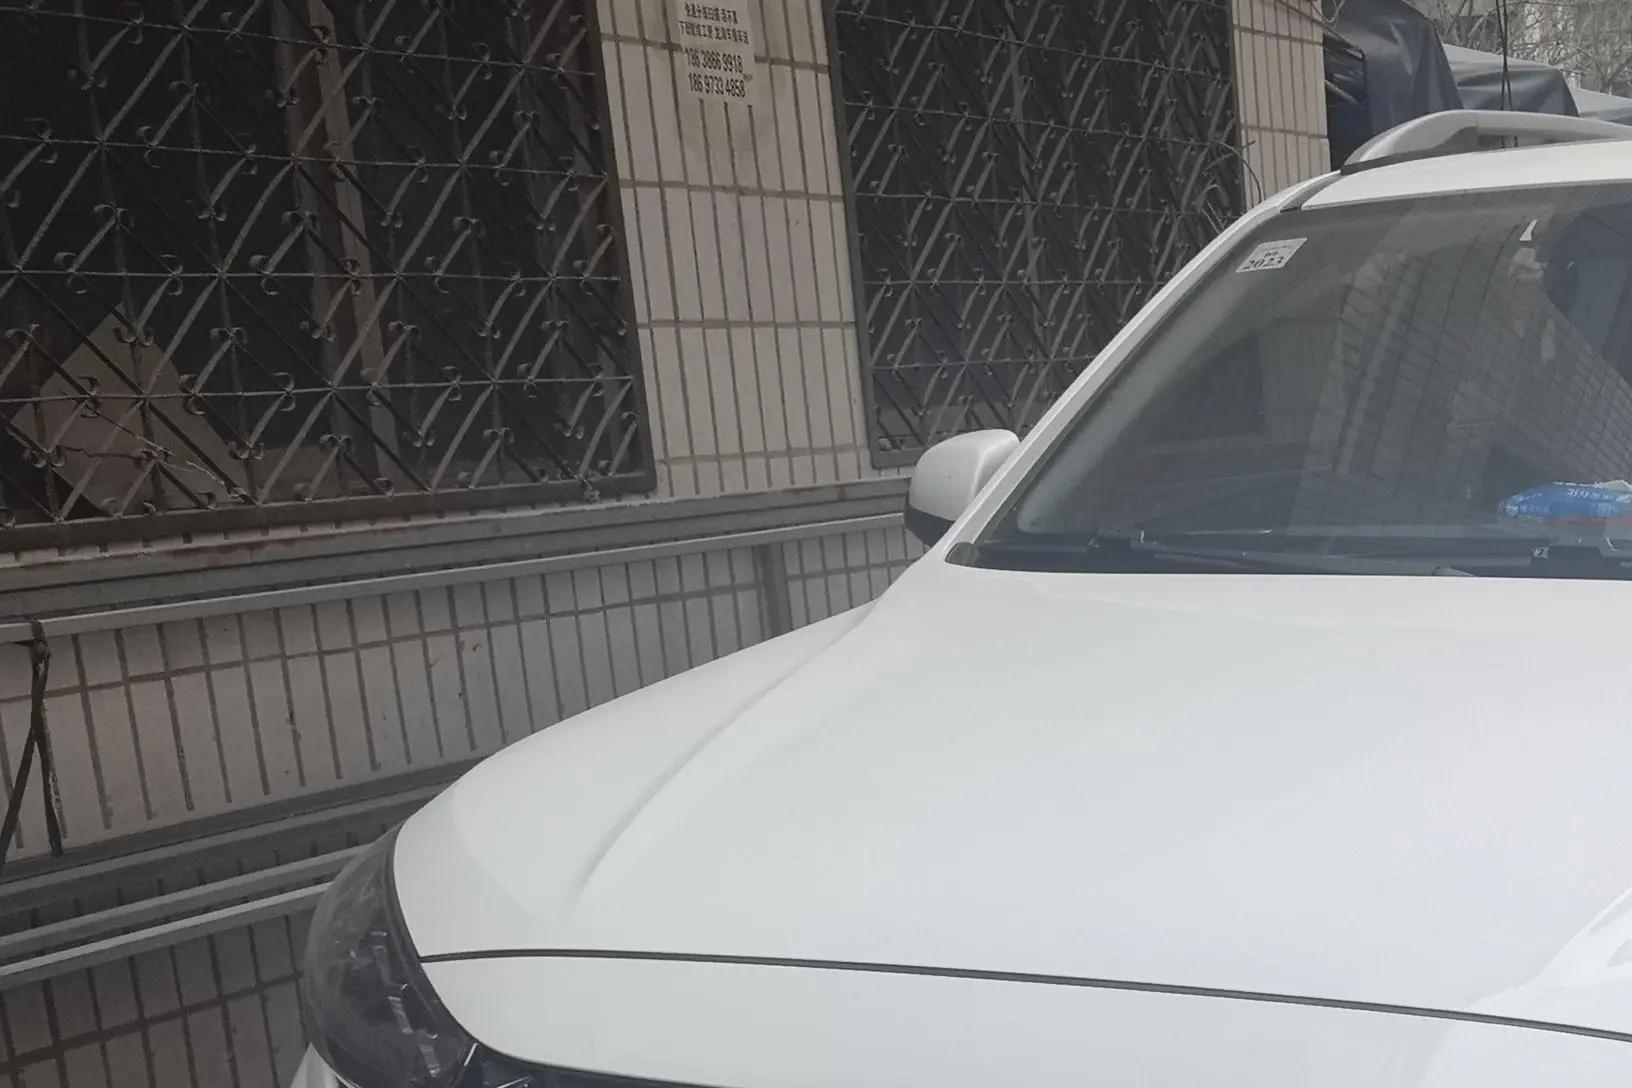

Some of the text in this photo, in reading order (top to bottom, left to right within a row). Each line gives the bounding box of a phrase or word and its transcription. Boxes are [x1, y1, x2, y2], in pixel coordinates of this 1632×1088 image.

[722, 52, 743, 74] 9918
[688, 72, 746, 98] 186 9733 4858
[1243, 256, 1284, 270] 2023
